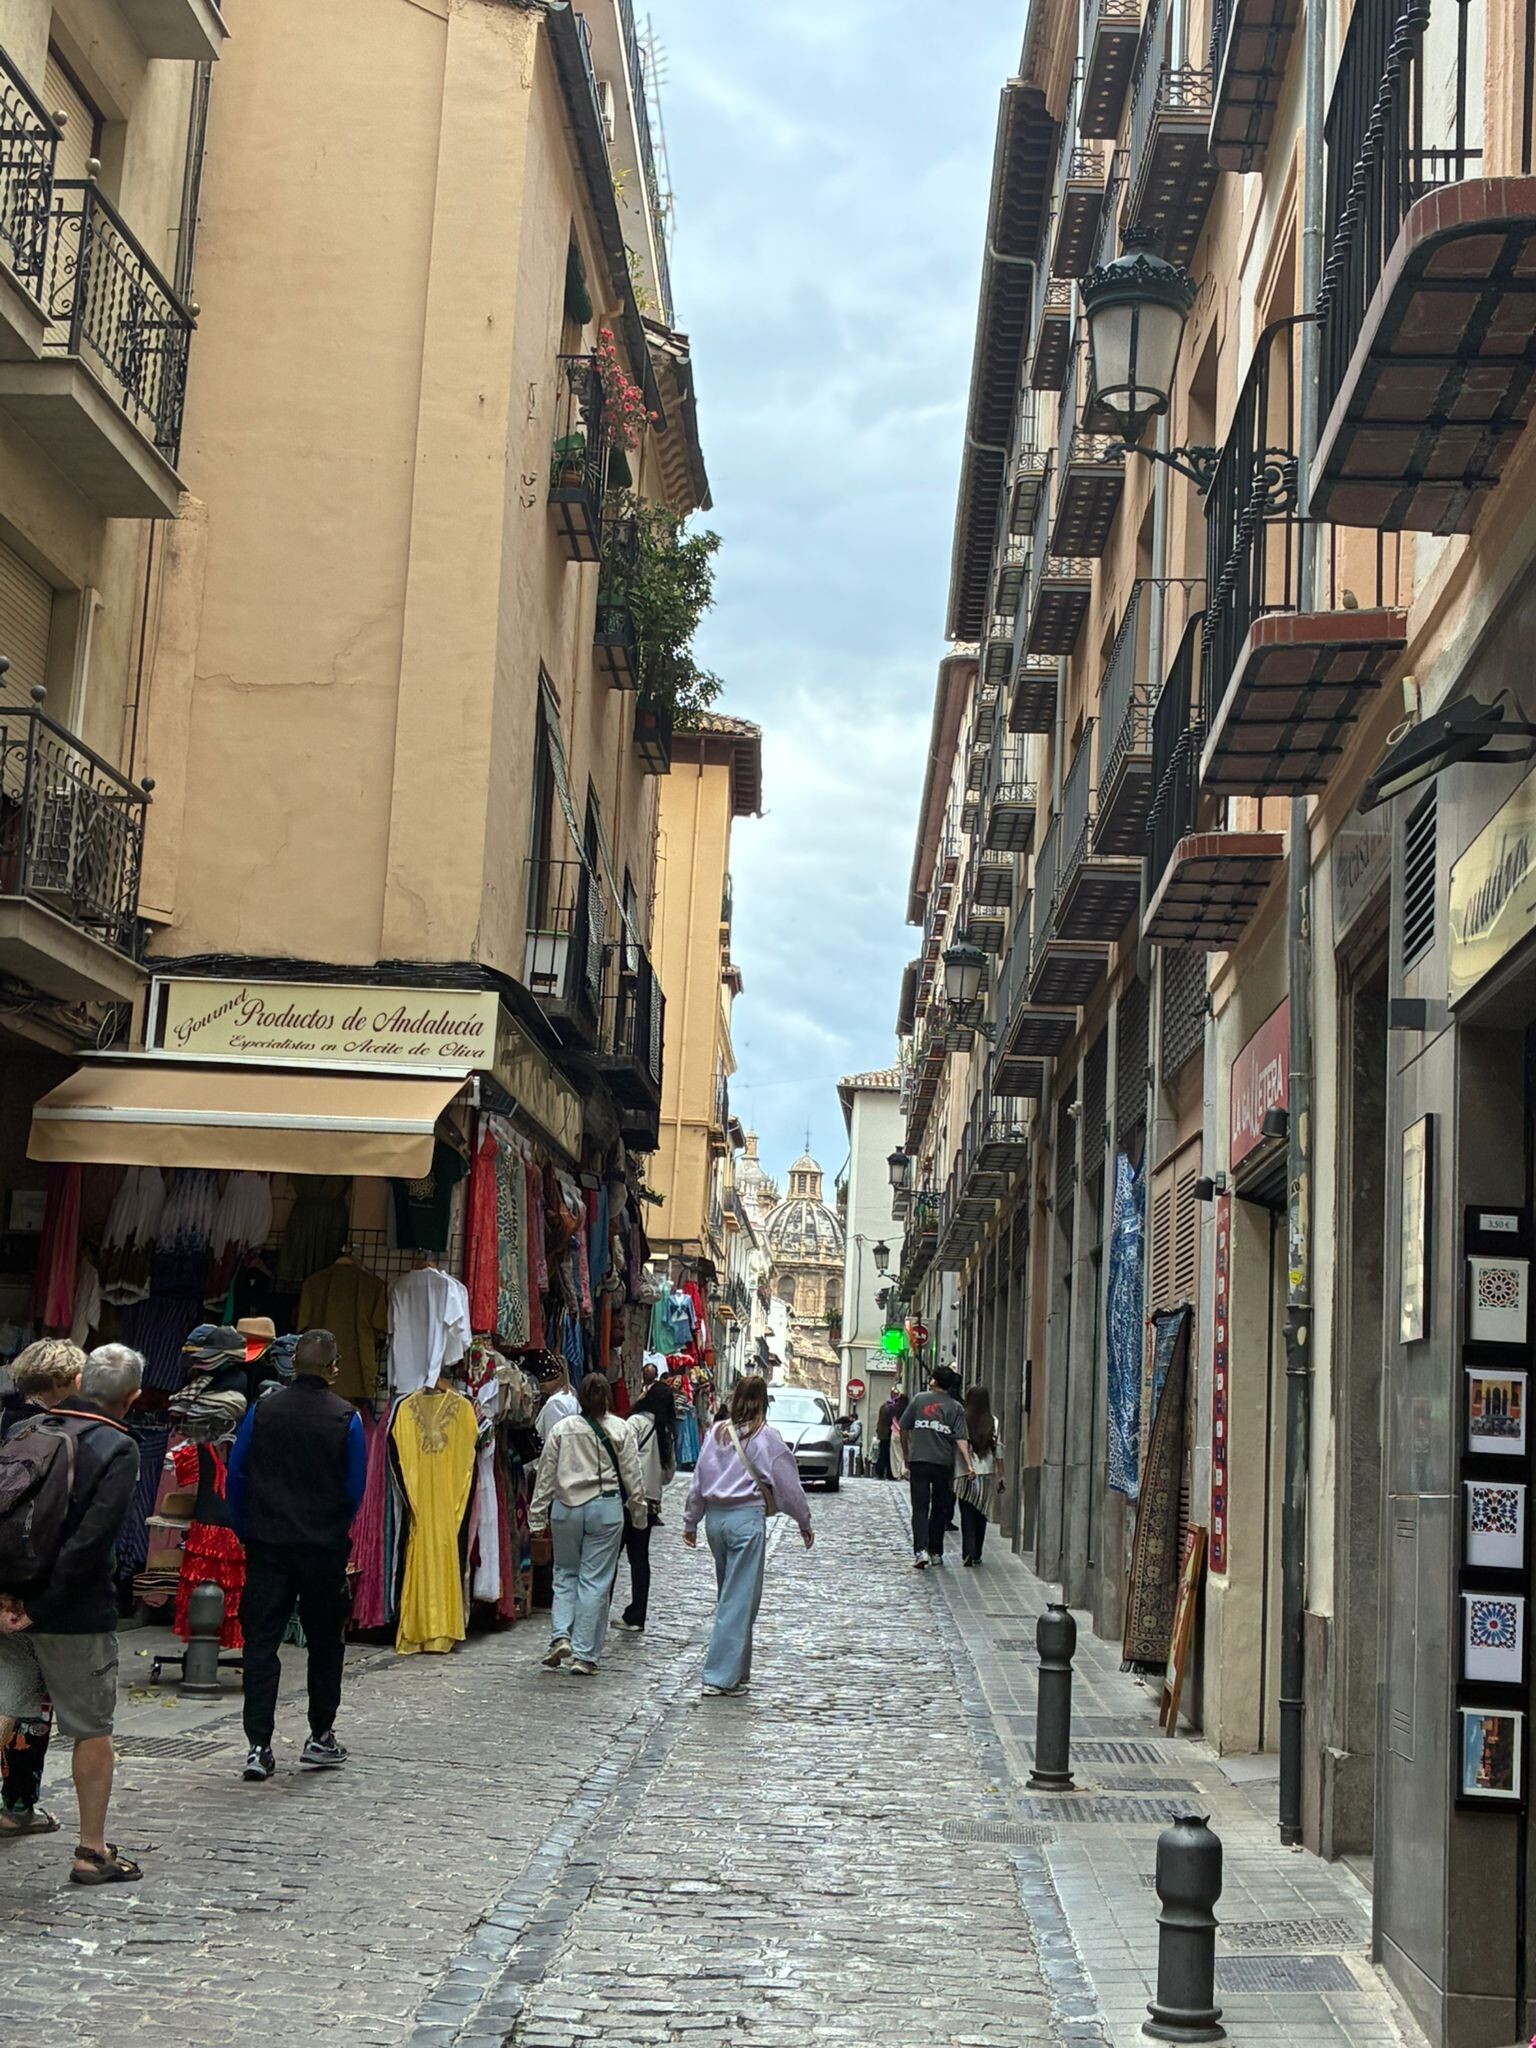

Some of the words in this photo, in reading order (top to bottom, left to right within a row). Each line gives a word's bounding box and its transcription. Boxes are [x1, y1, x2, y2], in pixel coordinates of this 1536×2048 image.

[173, 988, 250, 1047] Gourmet
[234, 999, 335, 1030] Productos
[341, 1006, 367, 1031] de
[372, 1006, 484, 1036] Andalucía
[229, 1034, 316, 1050] Especialistas
[320, 1043, 337, 1051] en
[343, 1039, 401, 1055] Aceite
[407, 1042, 431, 1056] de
[438, 1042, 486, 1058] Oliva
